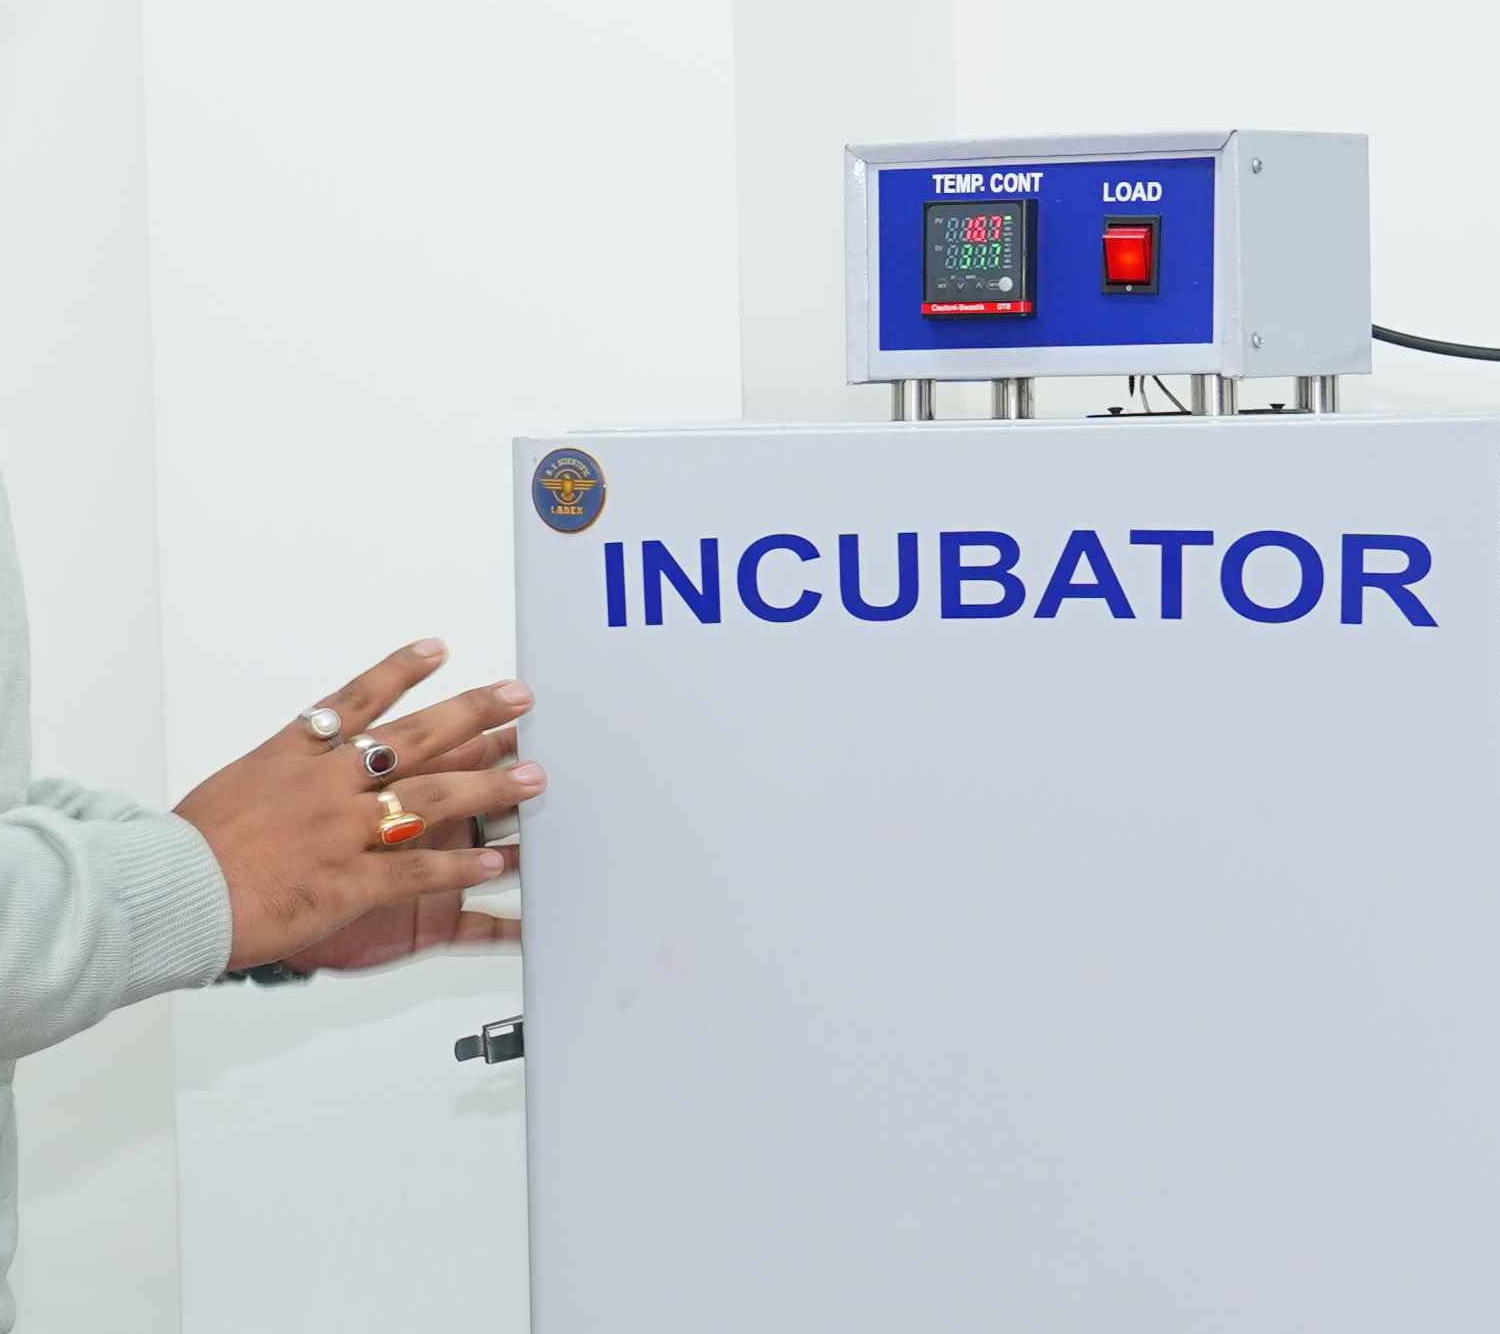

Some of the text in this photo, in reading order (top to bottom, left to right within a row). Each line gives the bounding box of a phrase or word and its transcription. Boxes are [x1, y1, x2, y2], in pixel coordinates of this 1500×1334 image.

[932, 172, 1044, 194] TEMP. CONT
[1103, 181, 1163, 202] LOAD
[603, 529, 1440, 628] INCUBATOR
